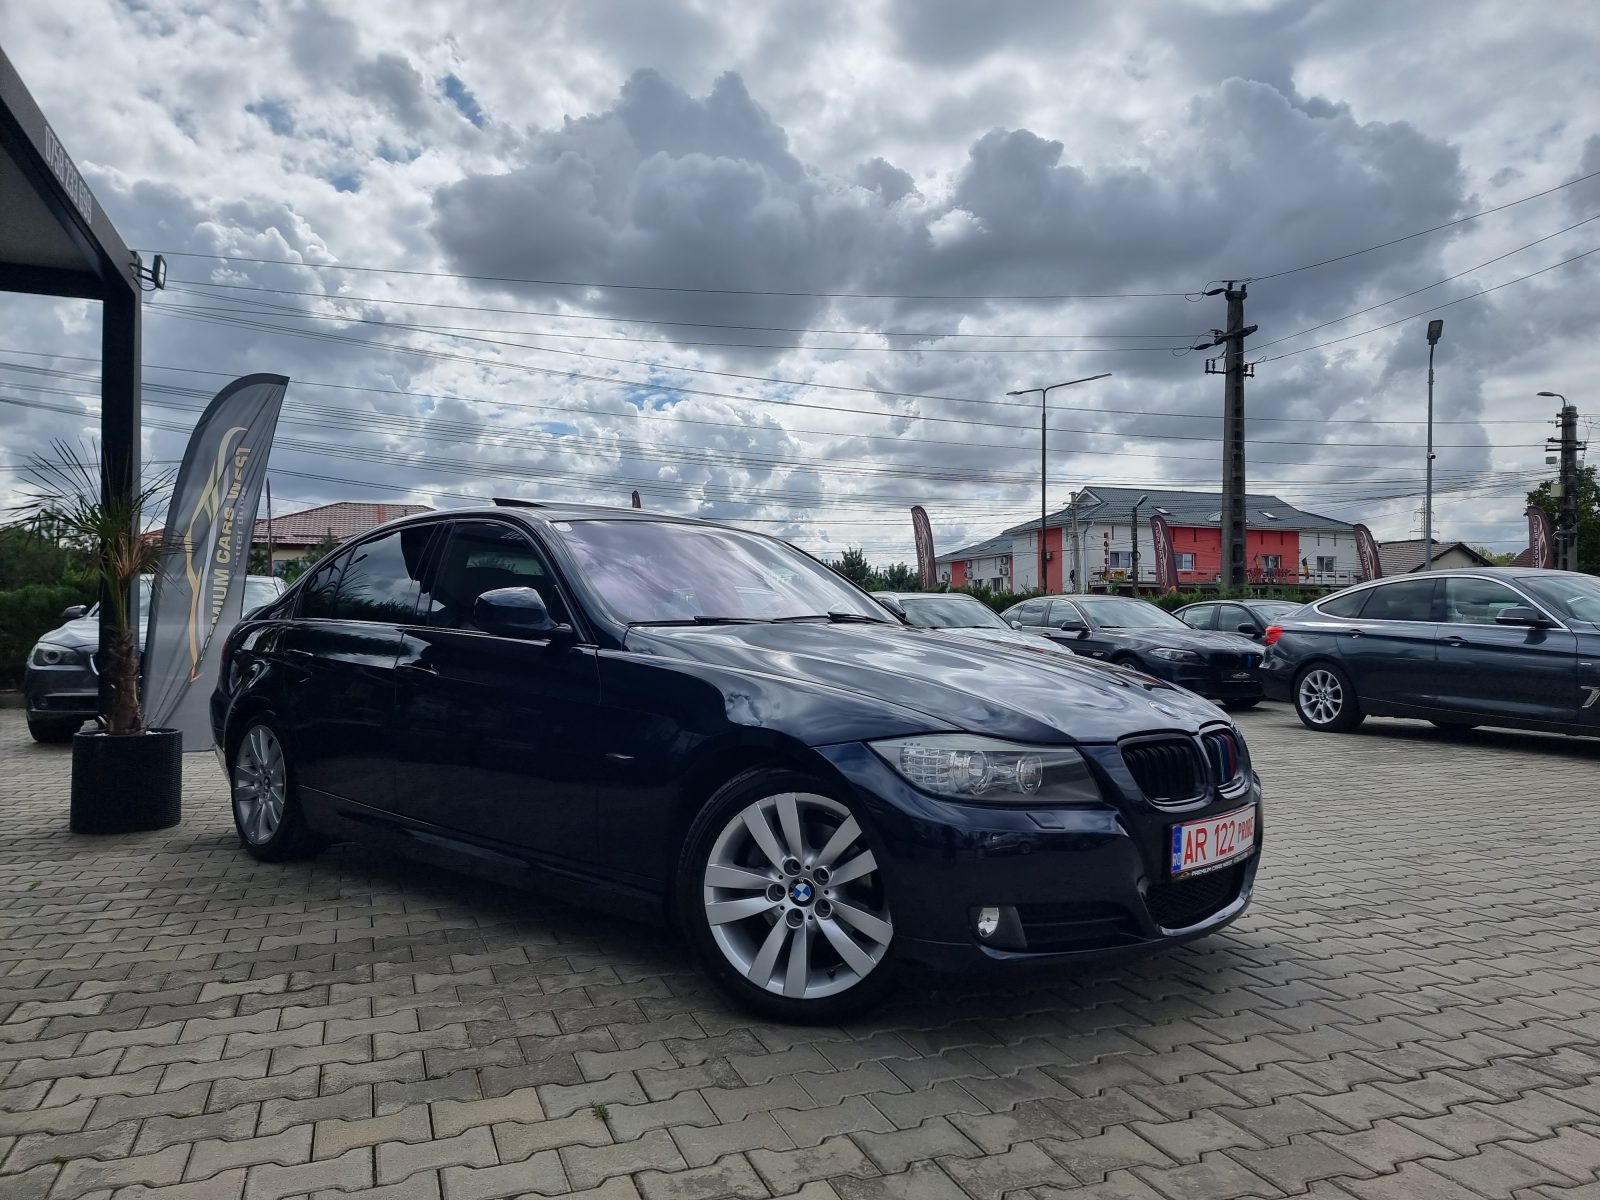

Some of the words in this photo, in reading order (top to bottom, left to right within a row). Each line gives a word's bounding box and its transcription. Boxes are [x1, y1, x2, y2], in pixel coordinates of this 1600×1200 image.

[45, 125, 64, 182] 0758
[65, 158, 78, 203] 233
[216, 507, 234, 564] CARS
[1184, 827, 1208, 865] AR
[1215, 820, 1235, 857] 122
